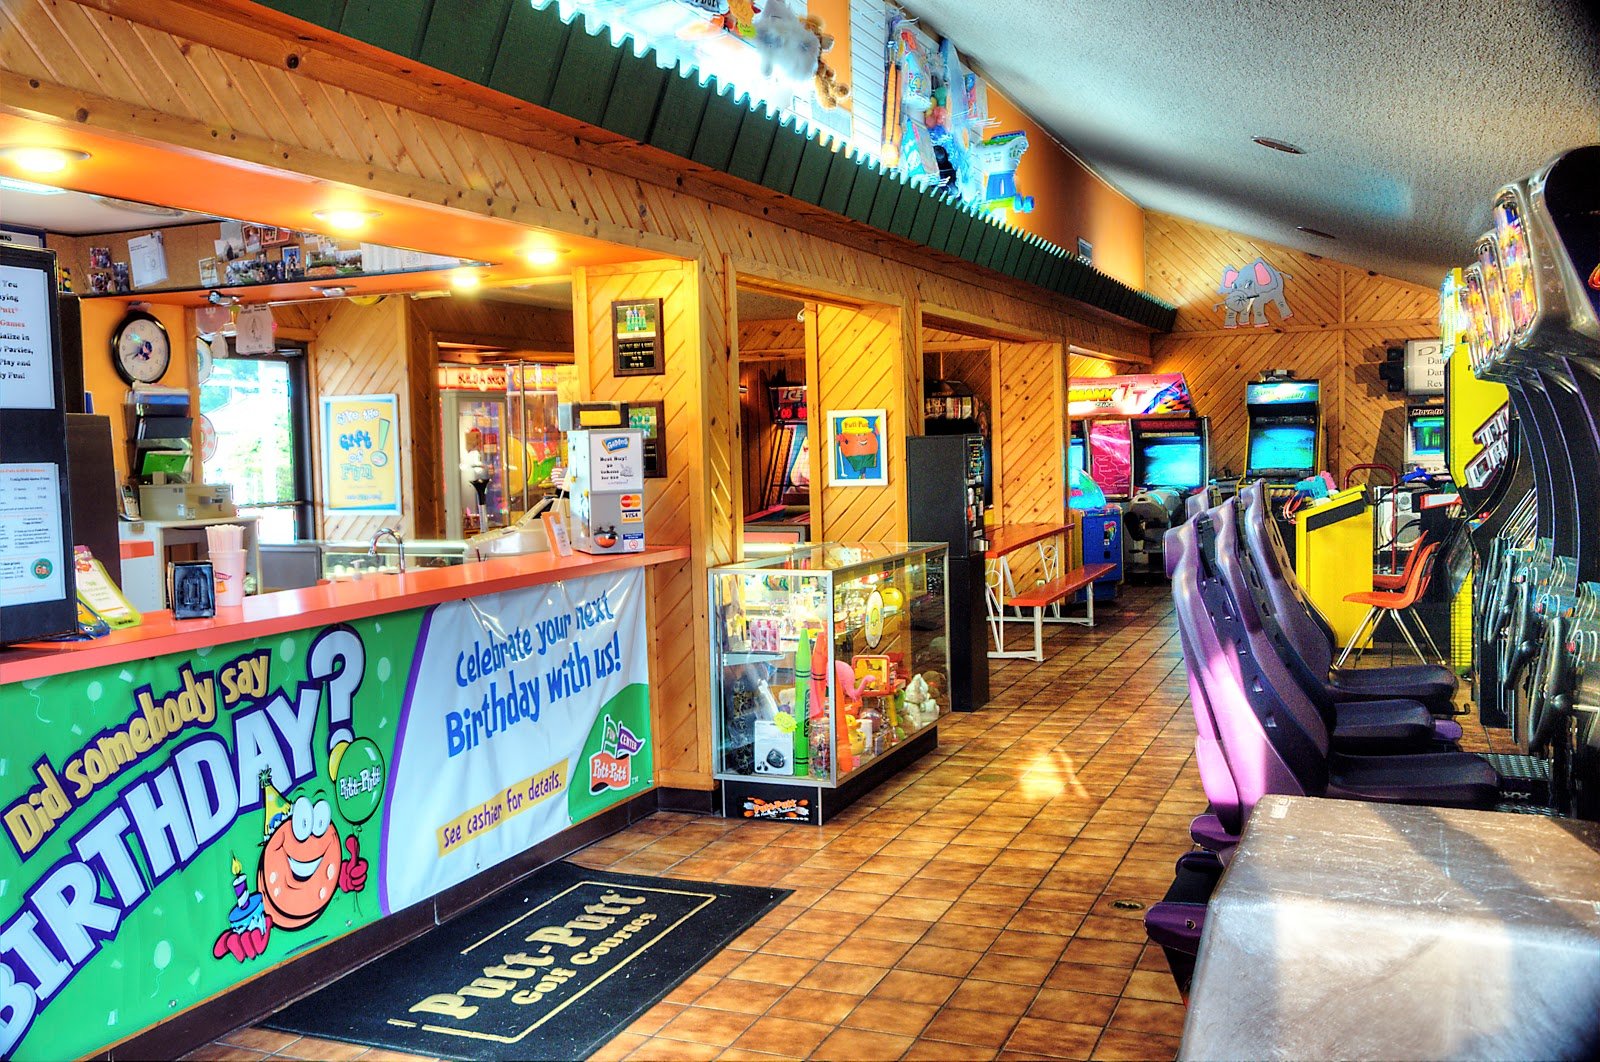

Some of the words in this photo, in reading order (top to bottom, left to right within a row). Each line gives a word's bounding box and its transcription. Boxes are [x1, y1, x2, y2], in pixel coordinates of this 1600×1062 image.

[456, 627, 532, 687] Celebrate
[536, 613, 572, 656] your
[575, 590, 614, 630] next
[445, 670, 541, 757] Birthday
[546, 641, 592, 704] with
[594, 630, 622, 680] us!
[4, 763, 71, 854] Did
[64, 668, 216, 800] somebody
[221, 655, 270, 704] say
[592, 759, 627, 782] Putt-Putt
[605, 726, 616, 742] FUN
[620, 733, 638, 751] CENTER
[339, 765, 381, 800] Putt-Putt
[443, 825, 462, 848] See
[467, 804, 503, 834] cashier
[506, 788, 523, 812] for
[528, 771, 562, 801] details.
[511, 967, 577, 1005] Golf
[570, 912, 658, 965] Courses
